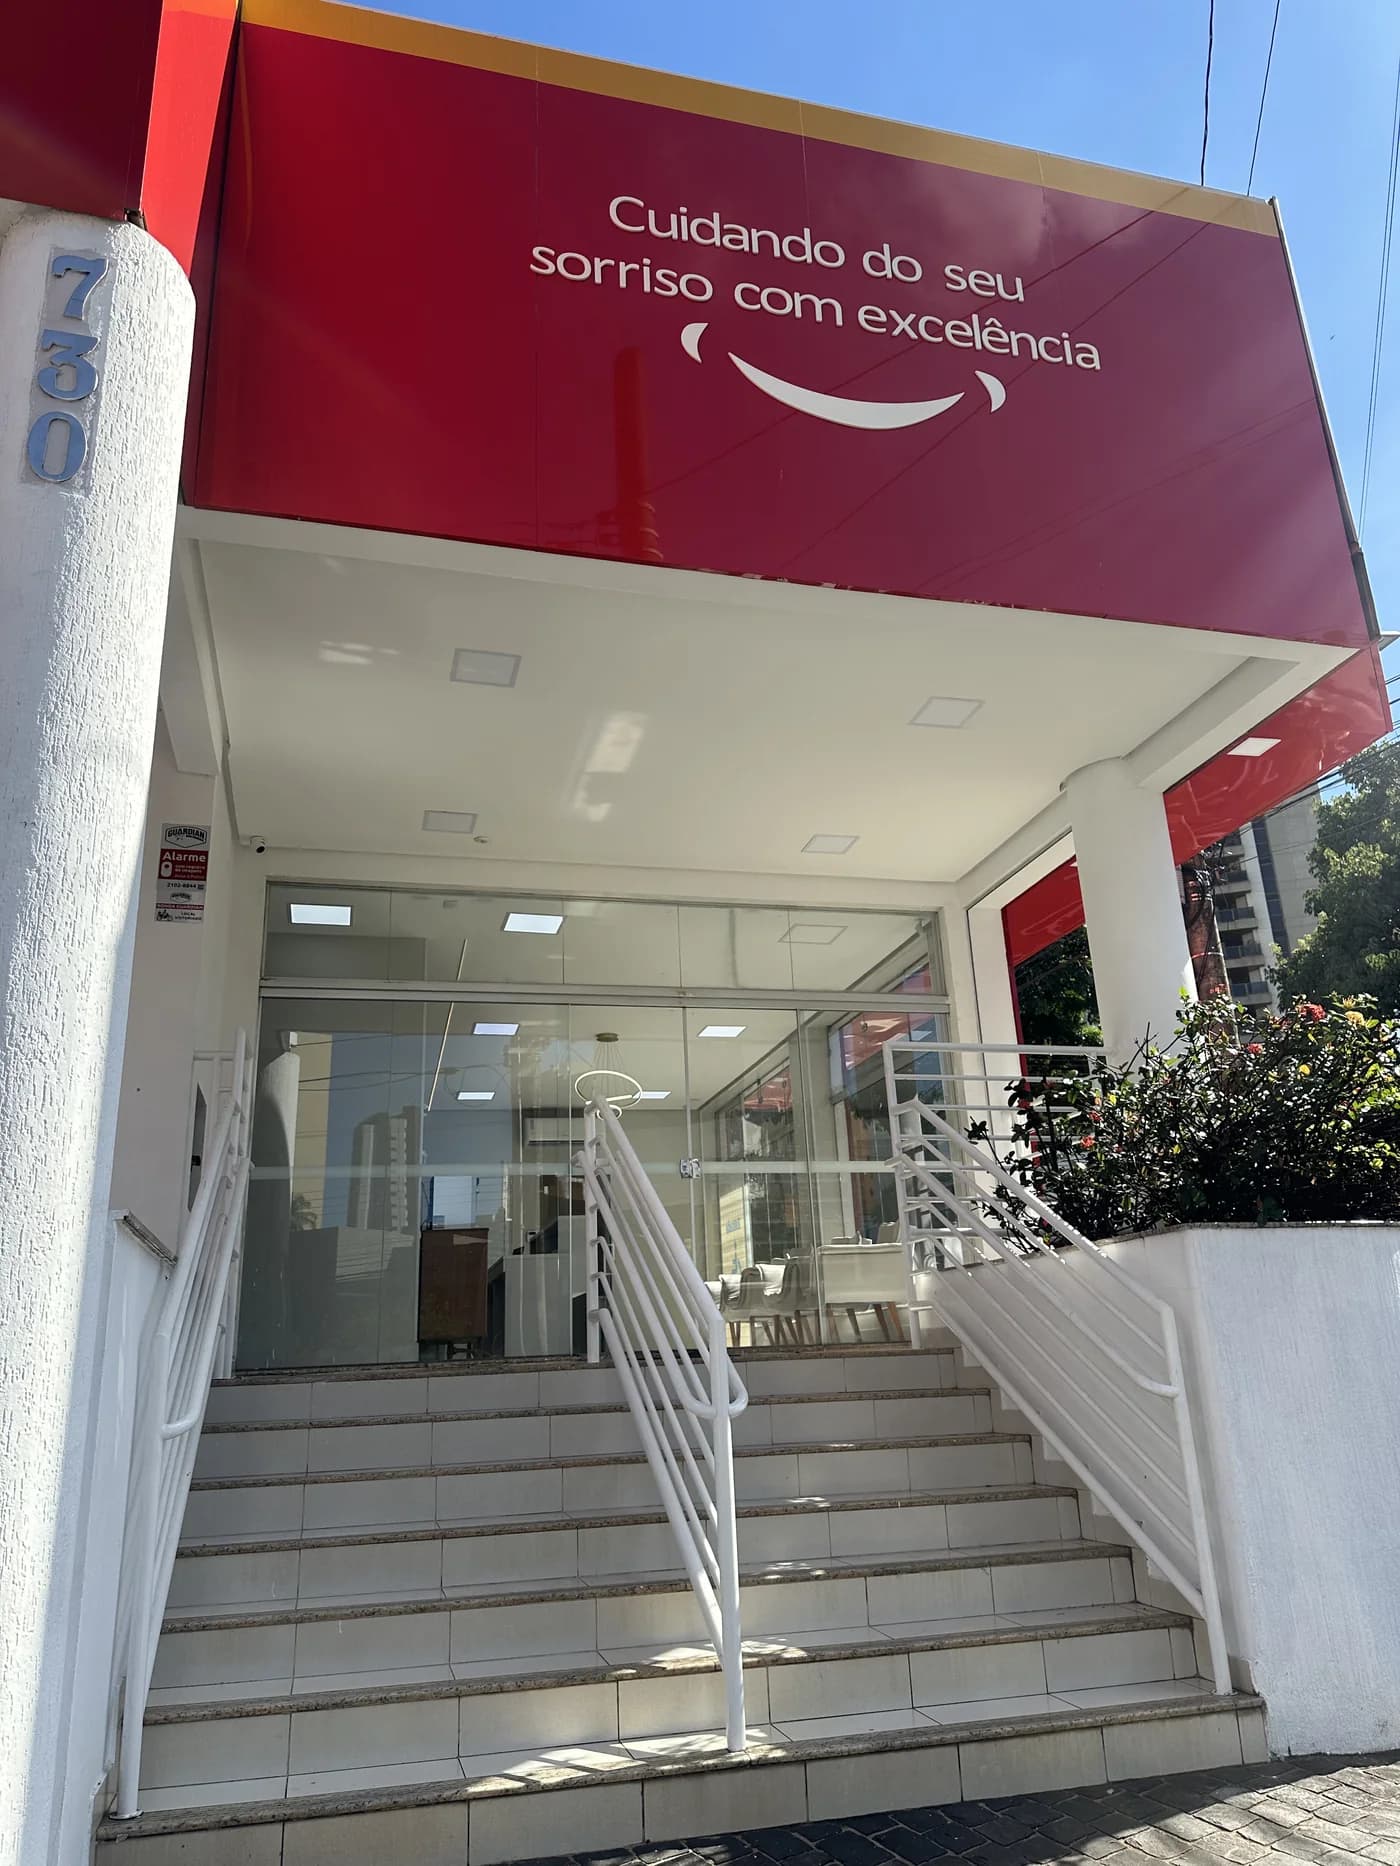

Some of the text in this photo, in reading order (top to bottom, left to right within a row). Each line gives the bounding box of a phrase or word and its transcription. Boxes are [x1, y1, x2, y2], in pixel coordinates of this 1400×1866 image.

[609, 195, 1025, 303] Cuidando do seu
[530, 244, 1102, 371] sorriso com excelência
[27, 255, 108, 482] 730
[162, 851, 206, 862] Alarme
[168, 828, 205, 839] GUARDIAN
